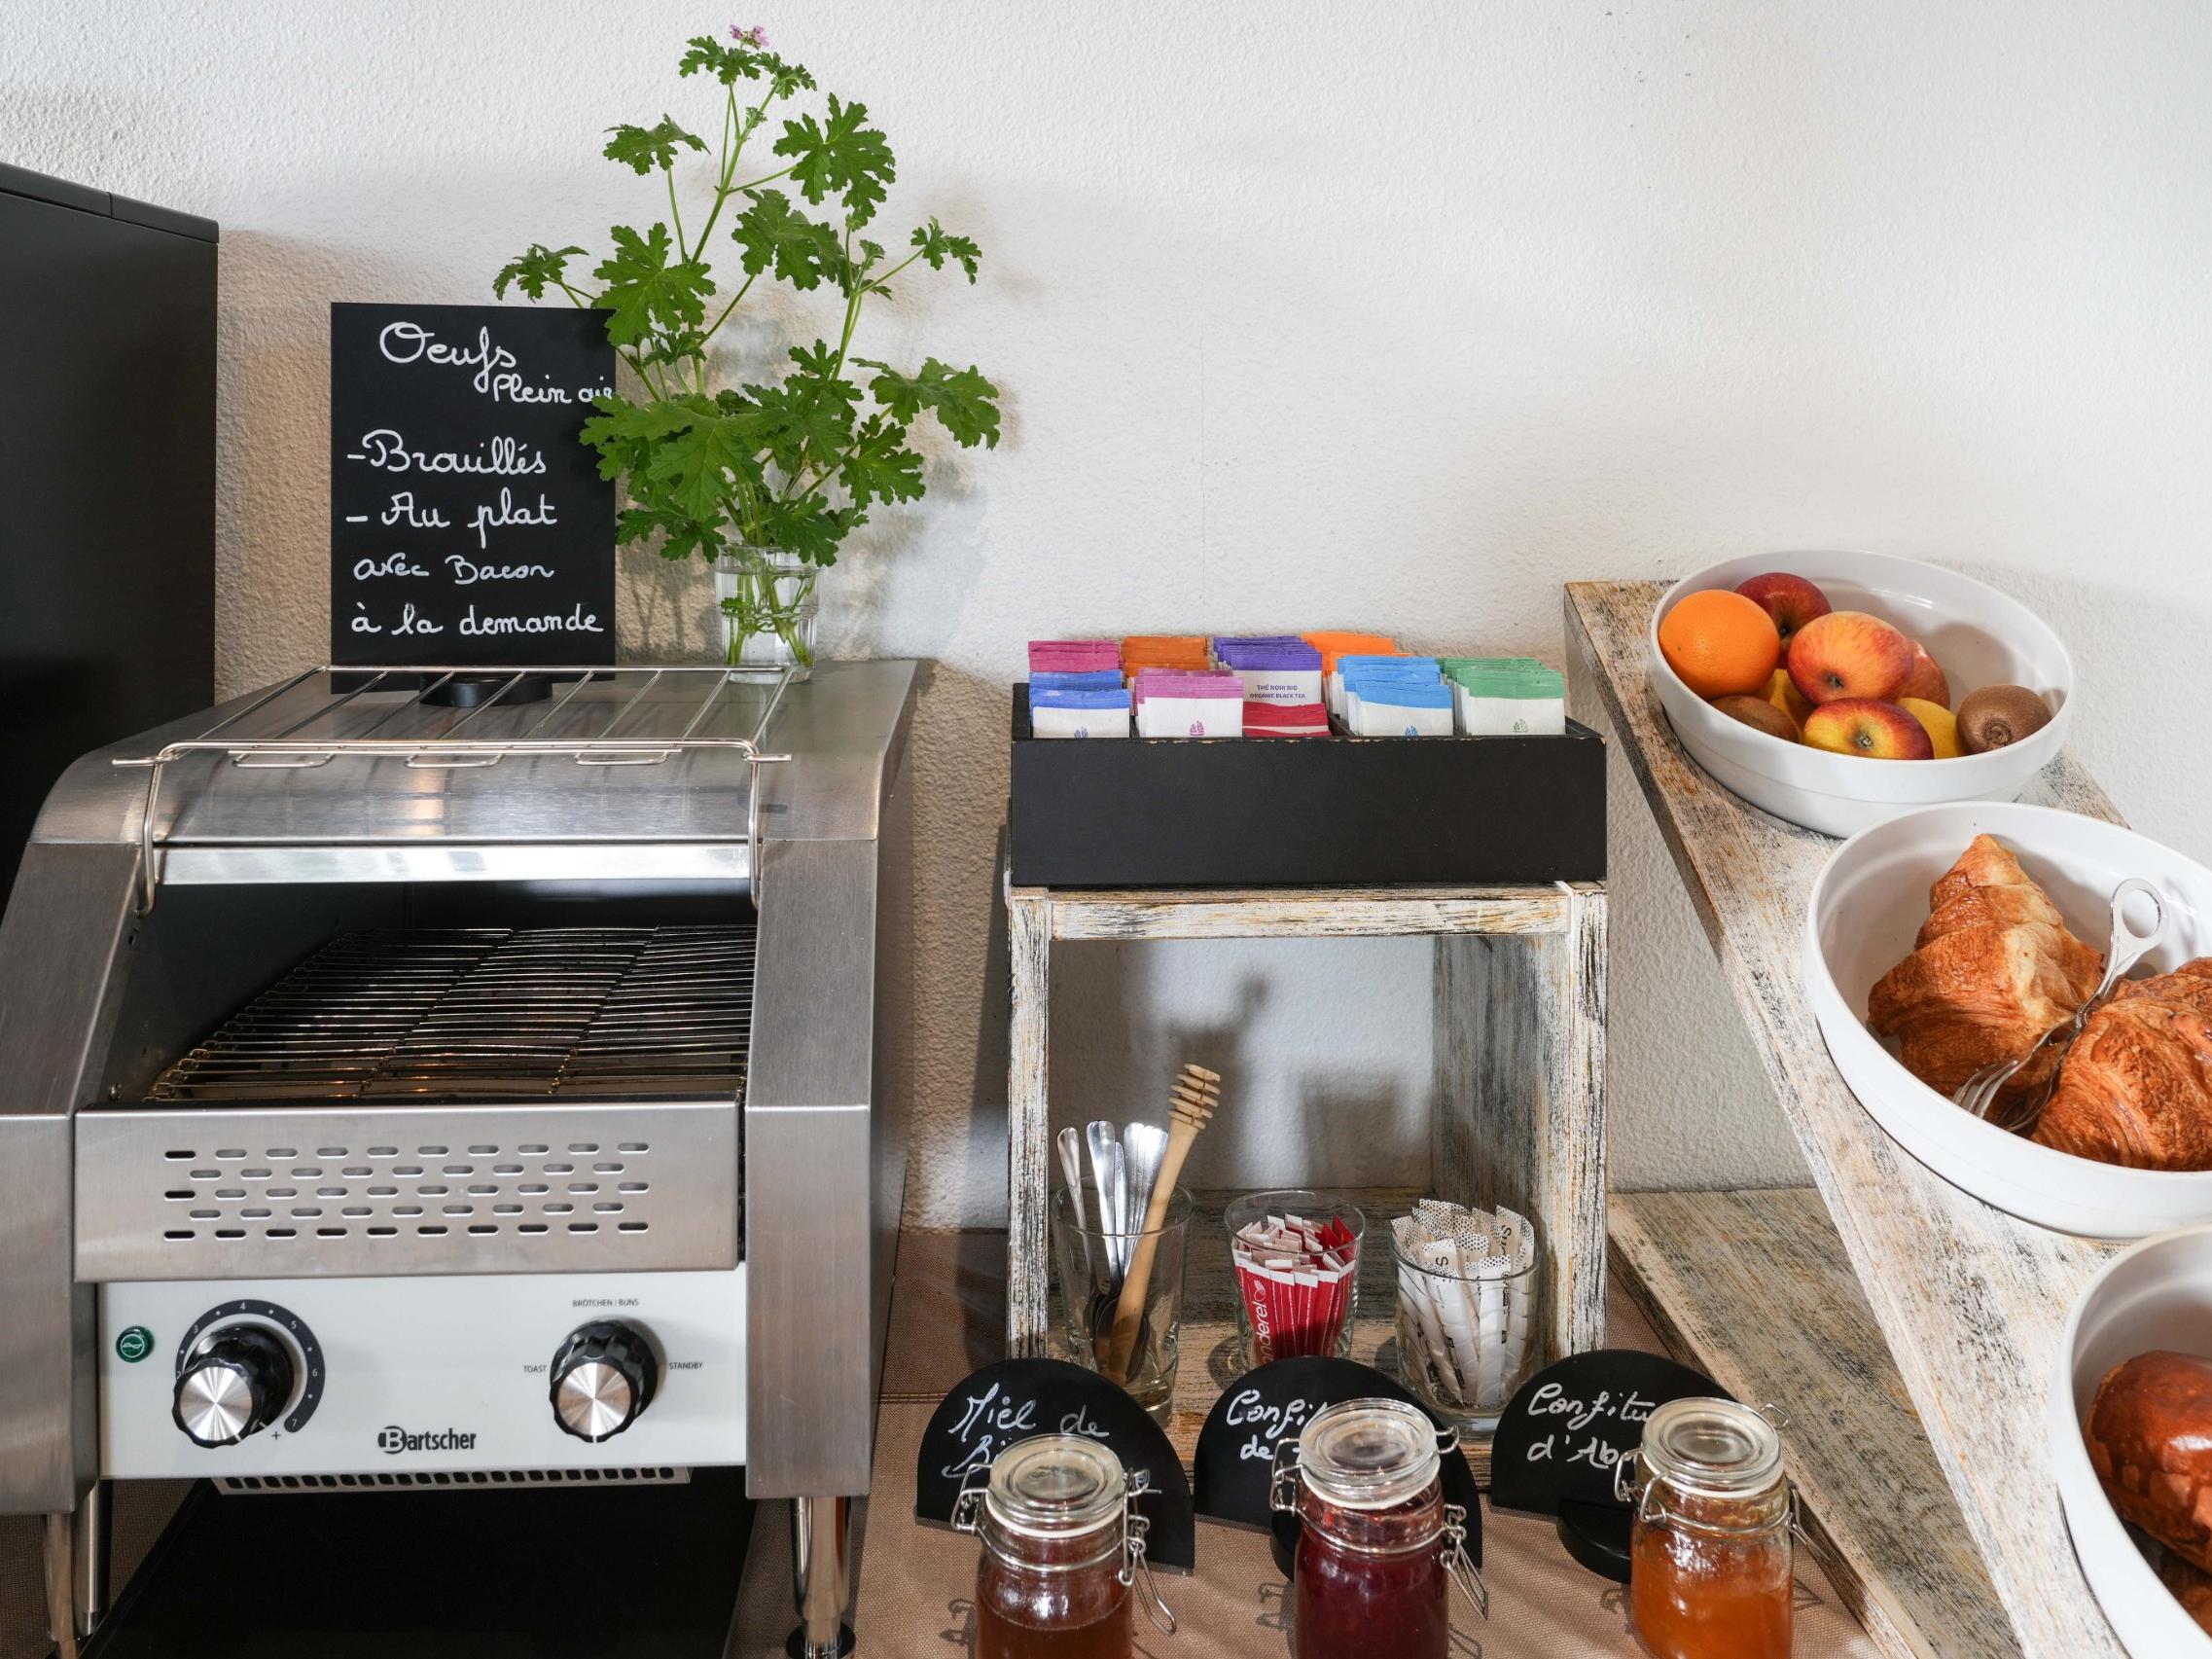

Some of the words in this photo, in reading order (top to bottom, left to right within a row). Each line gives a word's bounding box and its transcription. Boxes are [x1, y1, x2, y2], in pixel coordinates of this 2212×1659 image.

[378, 321, 517, 393] Oeufs
[492, 374, 572, 404] Plein
[381, 491, 450, 528] Au
[467, 487, 557, 549] plat
[353, 552, 430, 581] avec
[445, 554, 554, 585] Bacon
[350, 601, 382, 633] à
[391, 601, 444, 635] la
[459, 602, 604, 635] demande
[239, 1301, 246, 1311] 4
[618, 1298, 639, 1307] BUNS
[290, 1320, 297, 1329] 5
[311, 1367, 319, 1377] 6
[523, 1364, 547, 1373] TOAST
[668, 1361, 703, 1371] STANDBY
[1059, 1404, 1110, 1437] de
[1526, 1382, 1656, 1430] Confitu
[292, 1418, 298, 1427] 7
[377, 1425, 477, 1455] Bartscher
[1239, 1434, 1274, 1461] de
